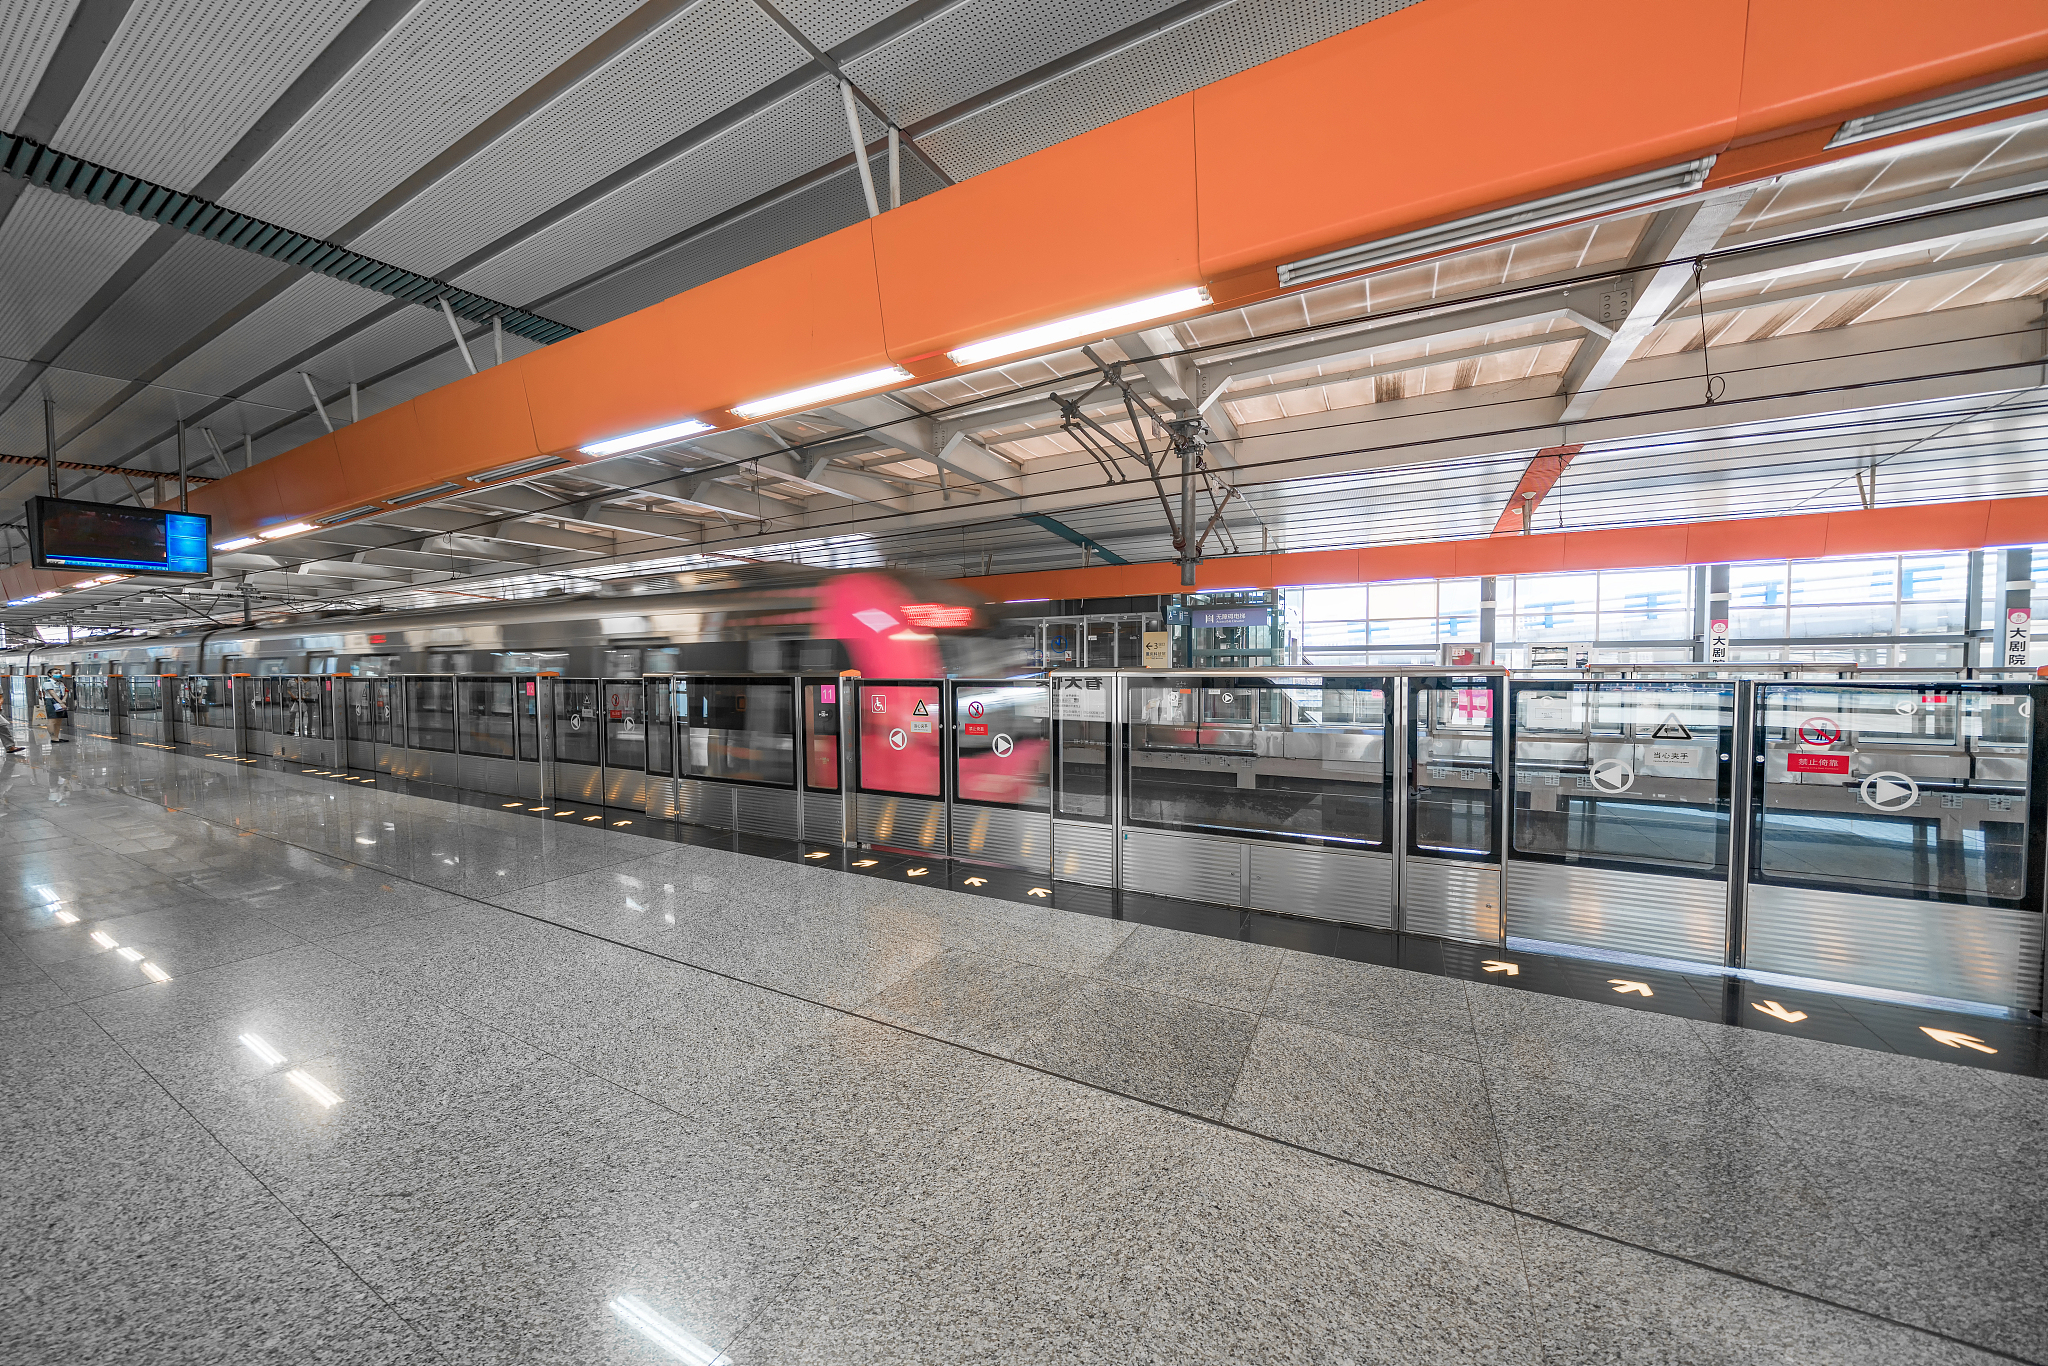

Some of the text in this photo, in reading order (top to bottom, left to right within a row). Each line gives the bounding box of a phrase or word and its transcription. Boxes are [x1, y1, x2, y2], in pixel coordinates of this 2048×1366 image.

[2009, 628, 2027, 665] 大剧院
[822, 688, 833, 700] 11
[1467, 695, 1489, 712] 10
[1653, 751, 1689, 760] 当心夹手
[1798, 758, 1839, 767] 禁止倚靠
